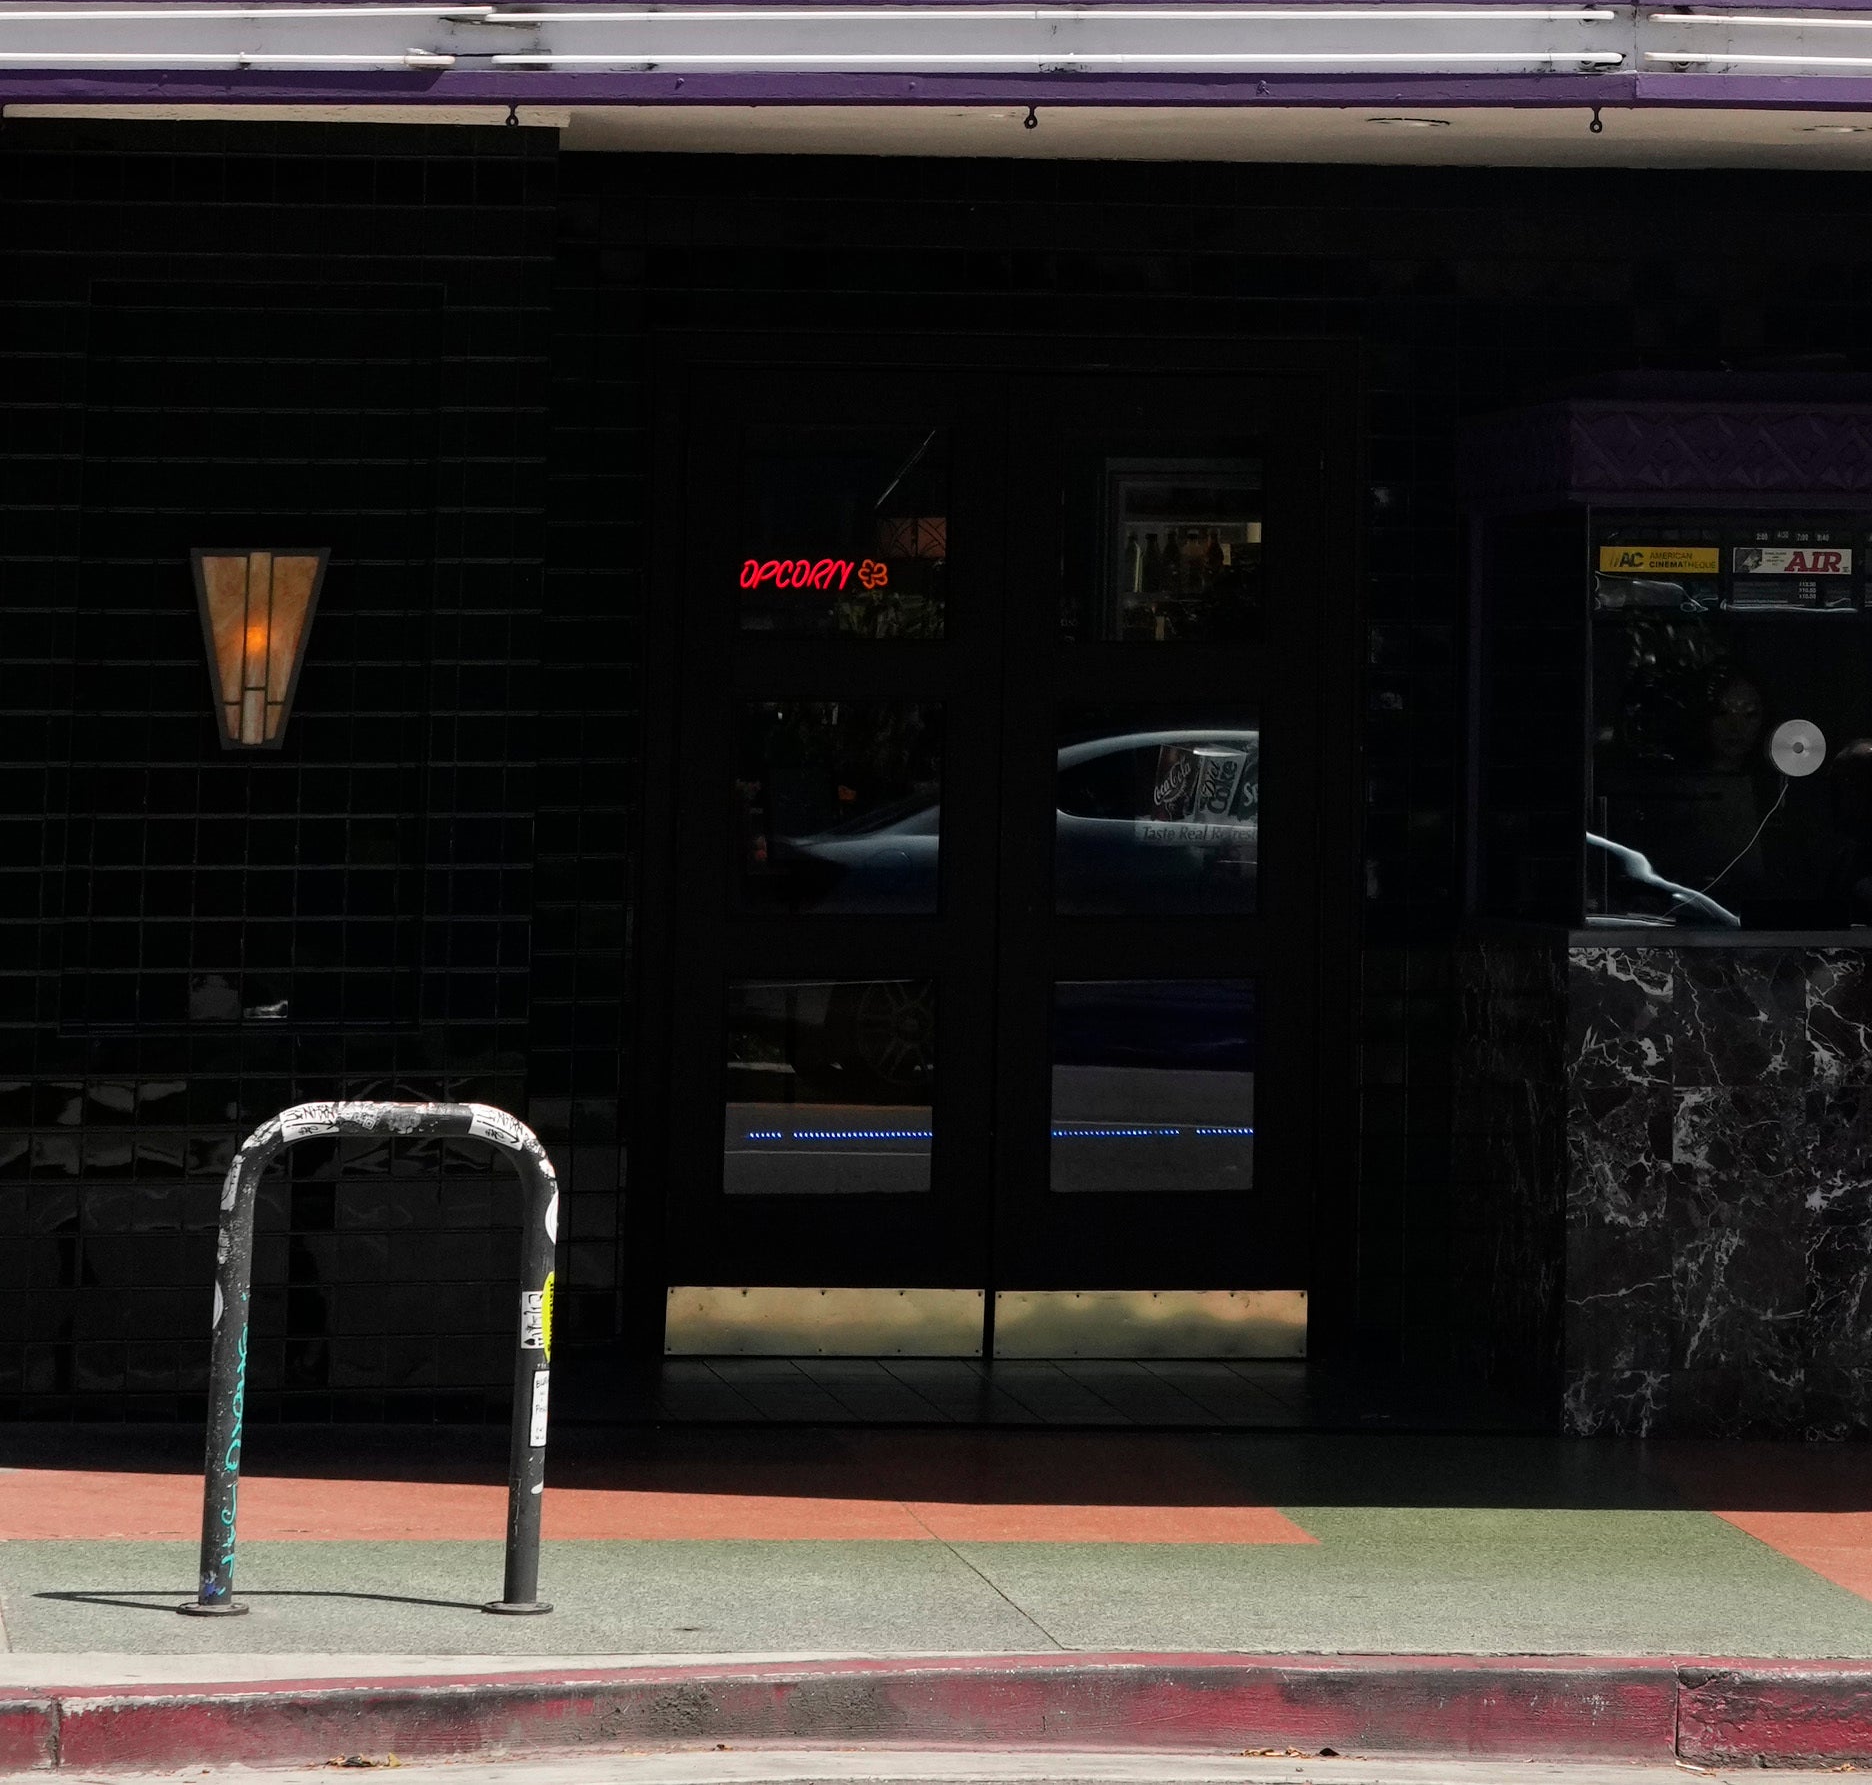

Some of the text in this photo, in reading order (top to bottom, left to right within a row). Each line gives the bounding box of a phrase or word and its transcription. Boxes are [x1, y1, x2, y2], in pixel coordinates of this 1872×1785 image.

[1619, 552, 1644, 568] AC
[1650, 552, 1693, 560] AMERICAN
[1784, 551, 1842, 573] AIR
[1649, 561, 1716, 569] CINEMATHEQUE
[739, 558, 854, 590] OPCORN
